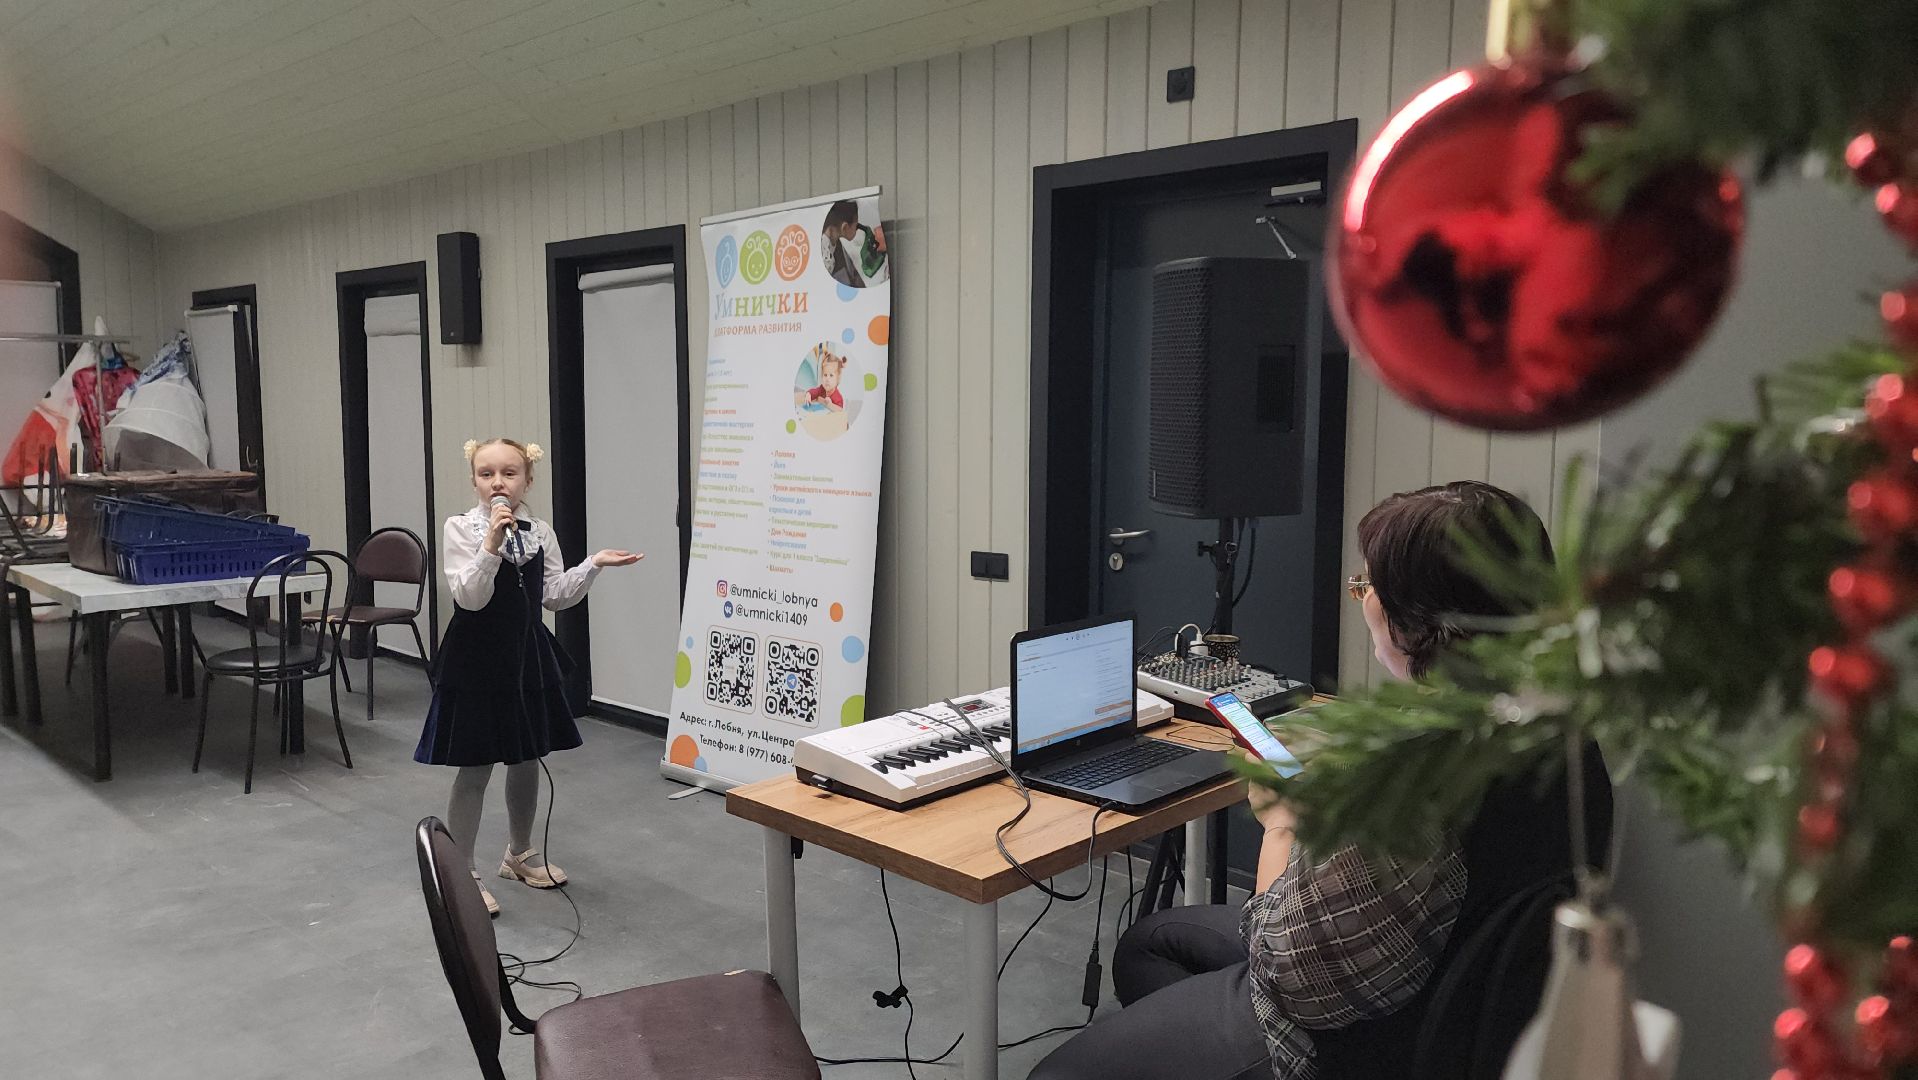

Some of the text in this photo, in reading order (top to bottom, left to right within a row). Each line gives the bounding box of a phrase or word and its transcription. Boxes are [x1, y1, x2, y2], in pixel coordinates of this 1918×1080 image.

[758, 322, 802, 335] РАЗВИТИЯ
[730, 584, 818, 609] @umnicki_lobnya
[736, 604, 808, 626] @umnicki1409
[680, 711, 707, 726] Адрес:
[699, 733, 737, 752] Телефон:
[738, 744, 744, 754] 8
[746, 745, 769, 763] (977)
